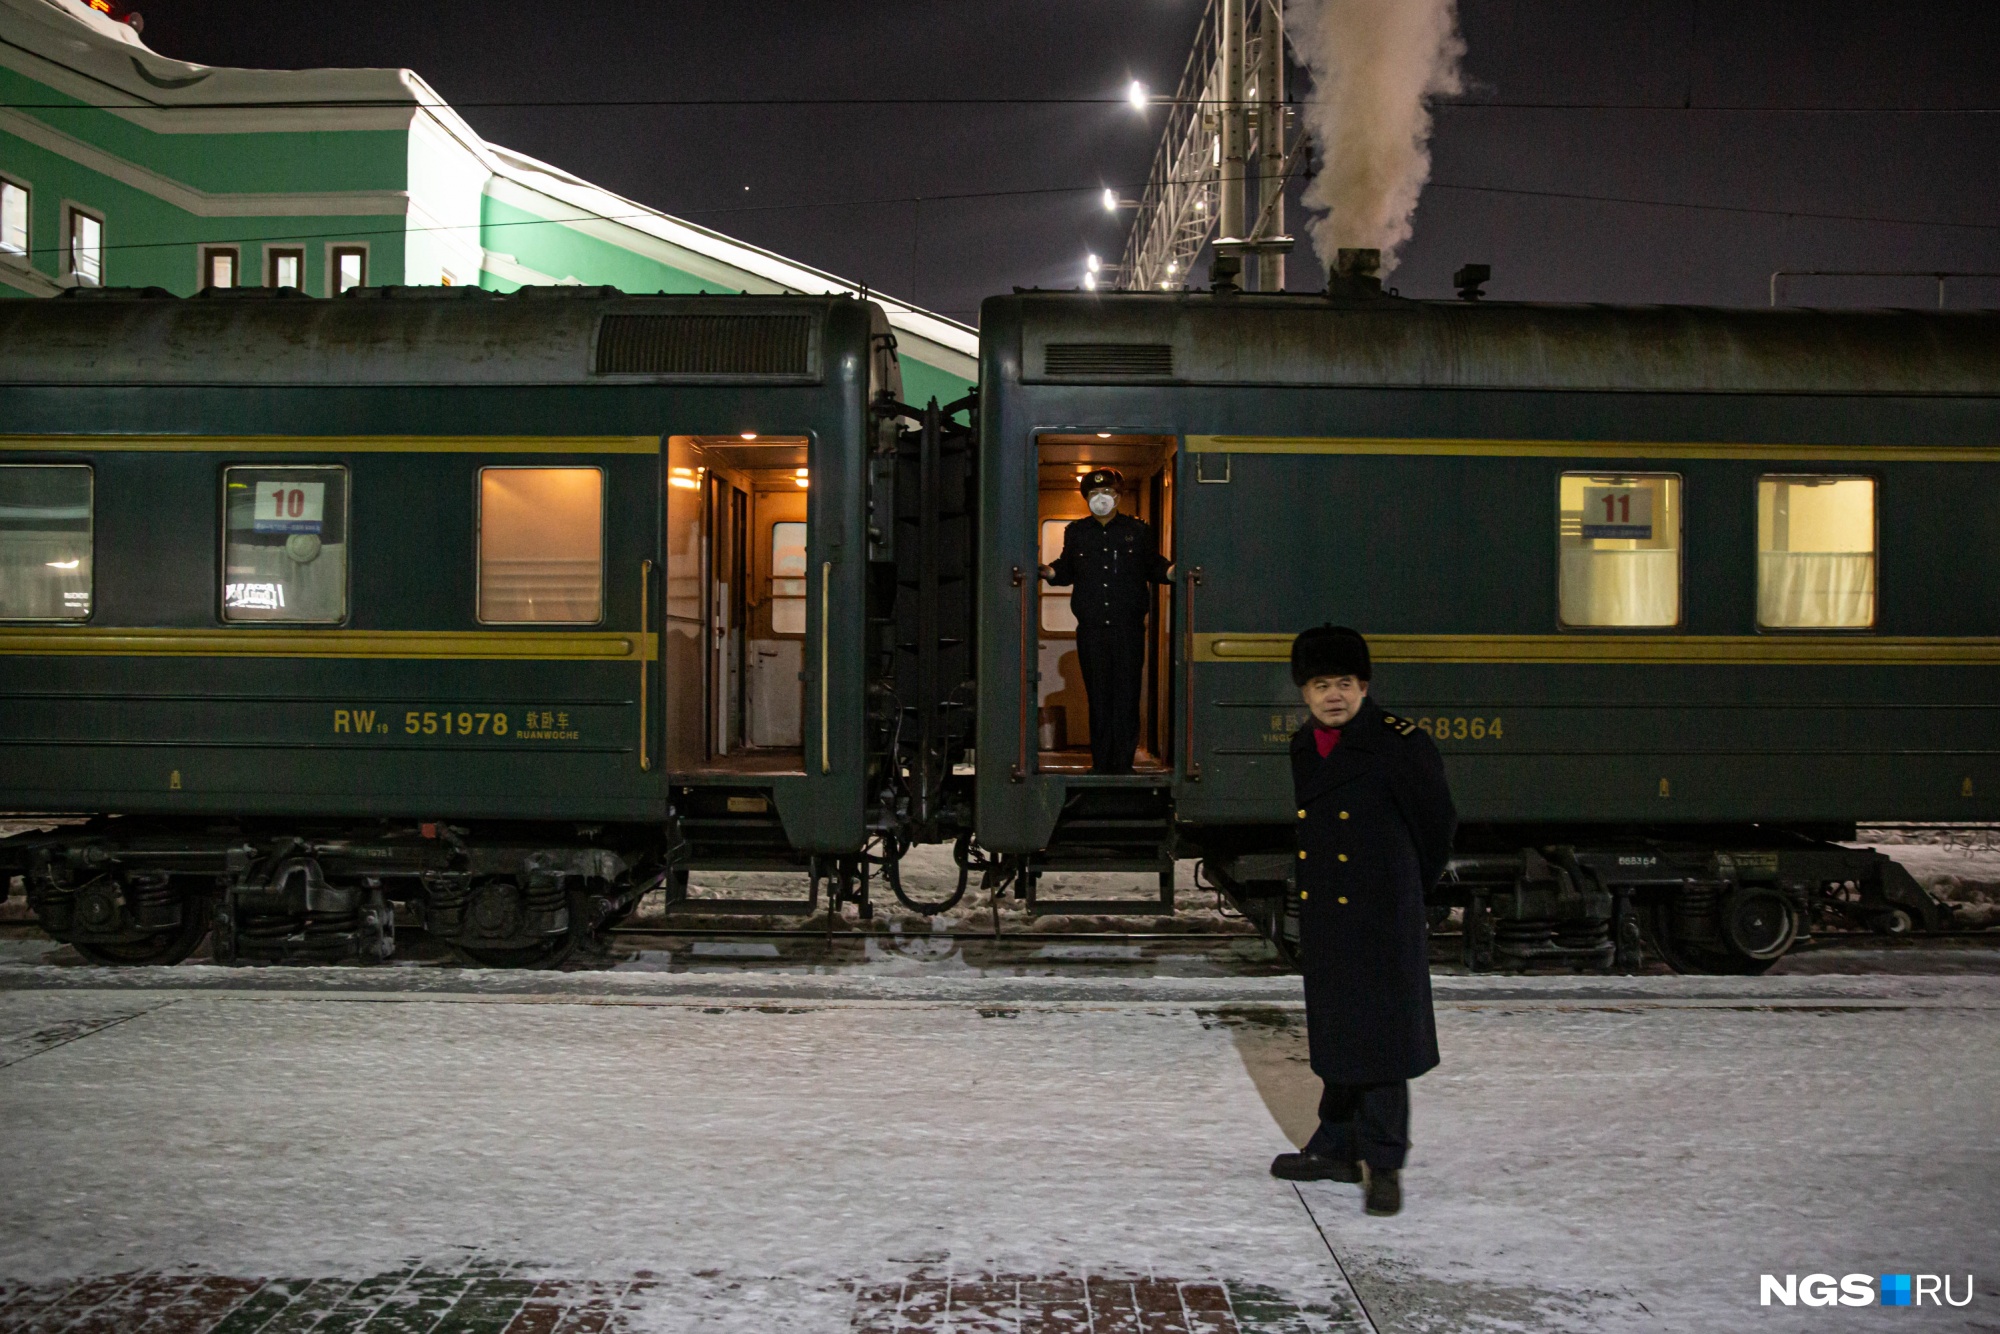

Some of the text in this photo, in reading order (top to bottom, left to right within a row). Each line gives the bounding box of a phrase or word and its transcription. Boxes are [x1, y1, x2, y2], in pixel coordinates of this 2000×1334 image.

[272, 488, 305, 518] 10
[1601, 493, 1631, 523] 11
[404, 711, 509, 736] 551978
[516, 730, 579, 740] RUANWOCHE
